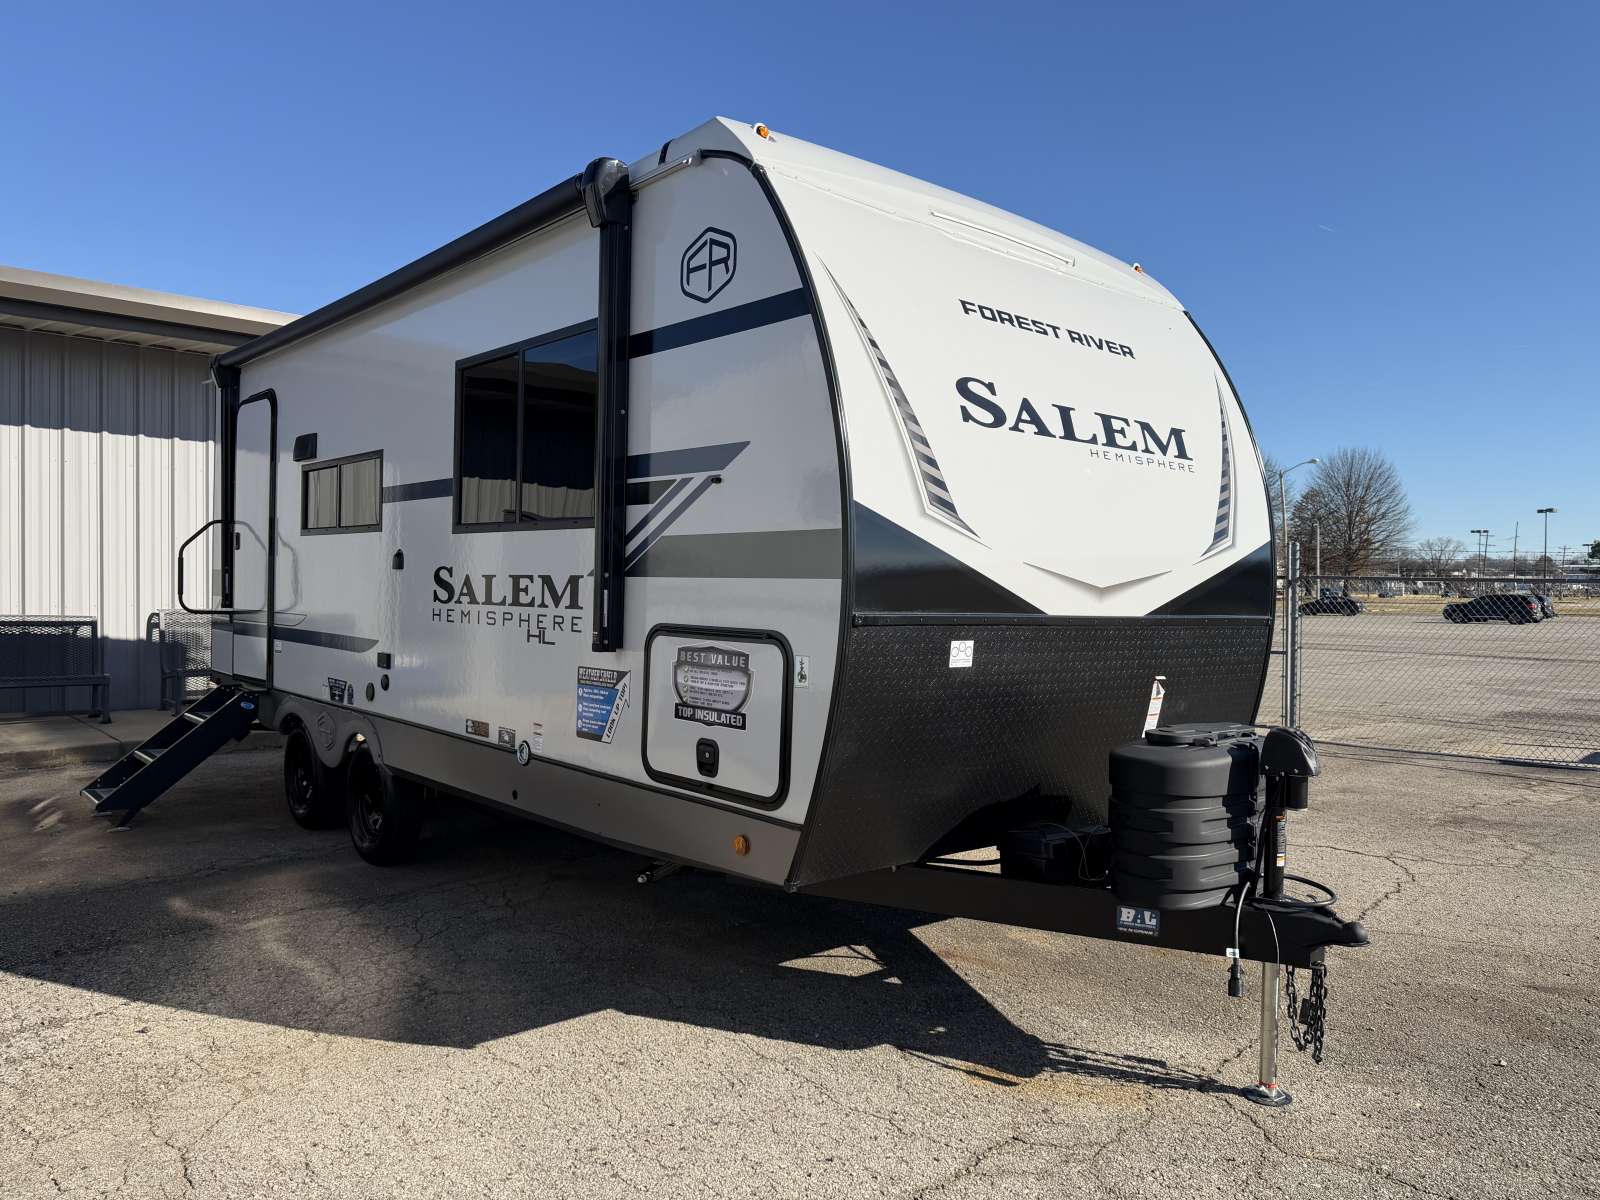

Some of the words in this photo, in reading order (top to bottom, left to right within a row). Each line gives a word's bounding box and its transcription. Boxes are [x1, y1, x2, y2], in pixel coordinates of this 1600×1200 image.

[958, 298, 1061, 339] FOREST
[1065, 328, 1136, 360] RIVER
[955, 376, 1194, 461] SALEM
[1090, 448, 1195, 473] HEMISPHERE
[433, 566, 584, 610] SALEM
[432, 608, 583, 633] HEMISPHERE
[526, 629, 556, 645] HL
[680, 651, 706, 664] BEST
[711, 653, 746, 668] VALUE
[678, 706, 693, 718] TOP
[695, 709, 743, 727] INSULATED
